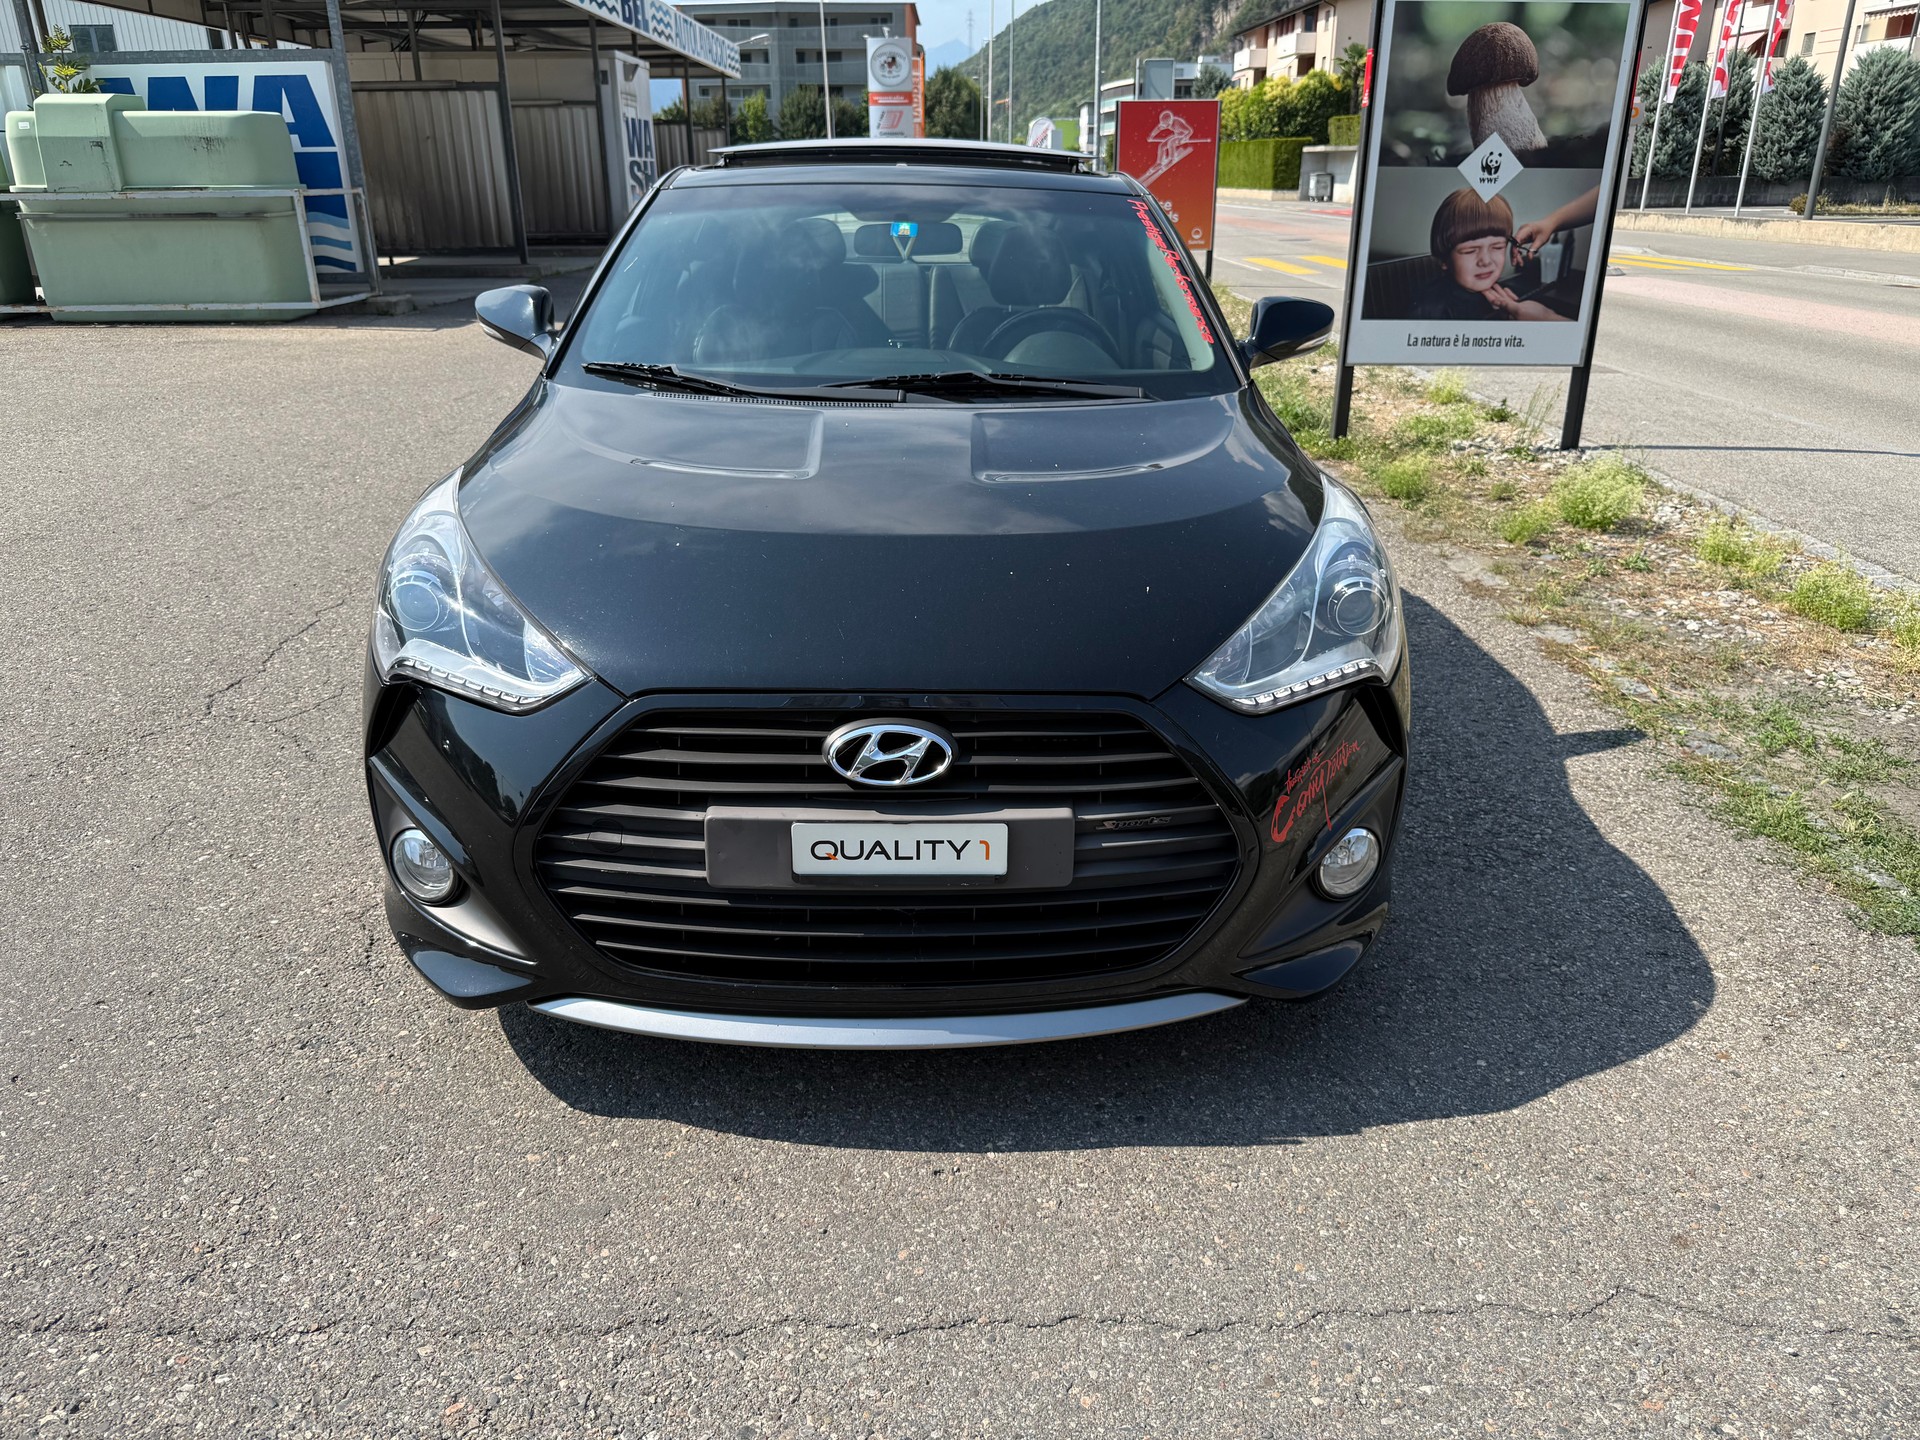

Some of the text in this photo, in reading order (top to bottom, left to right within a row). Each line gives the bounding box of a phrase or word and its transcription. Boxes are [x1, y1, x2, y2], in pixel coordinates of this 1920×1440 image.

[1479, 176, 1499, 184] WWF
[1161, 246, 1214, 344] Performance
[1407, 333, 1525, 348] La natura è la nostra vita.
[810, 839, 991, 861] QUALITY 1
